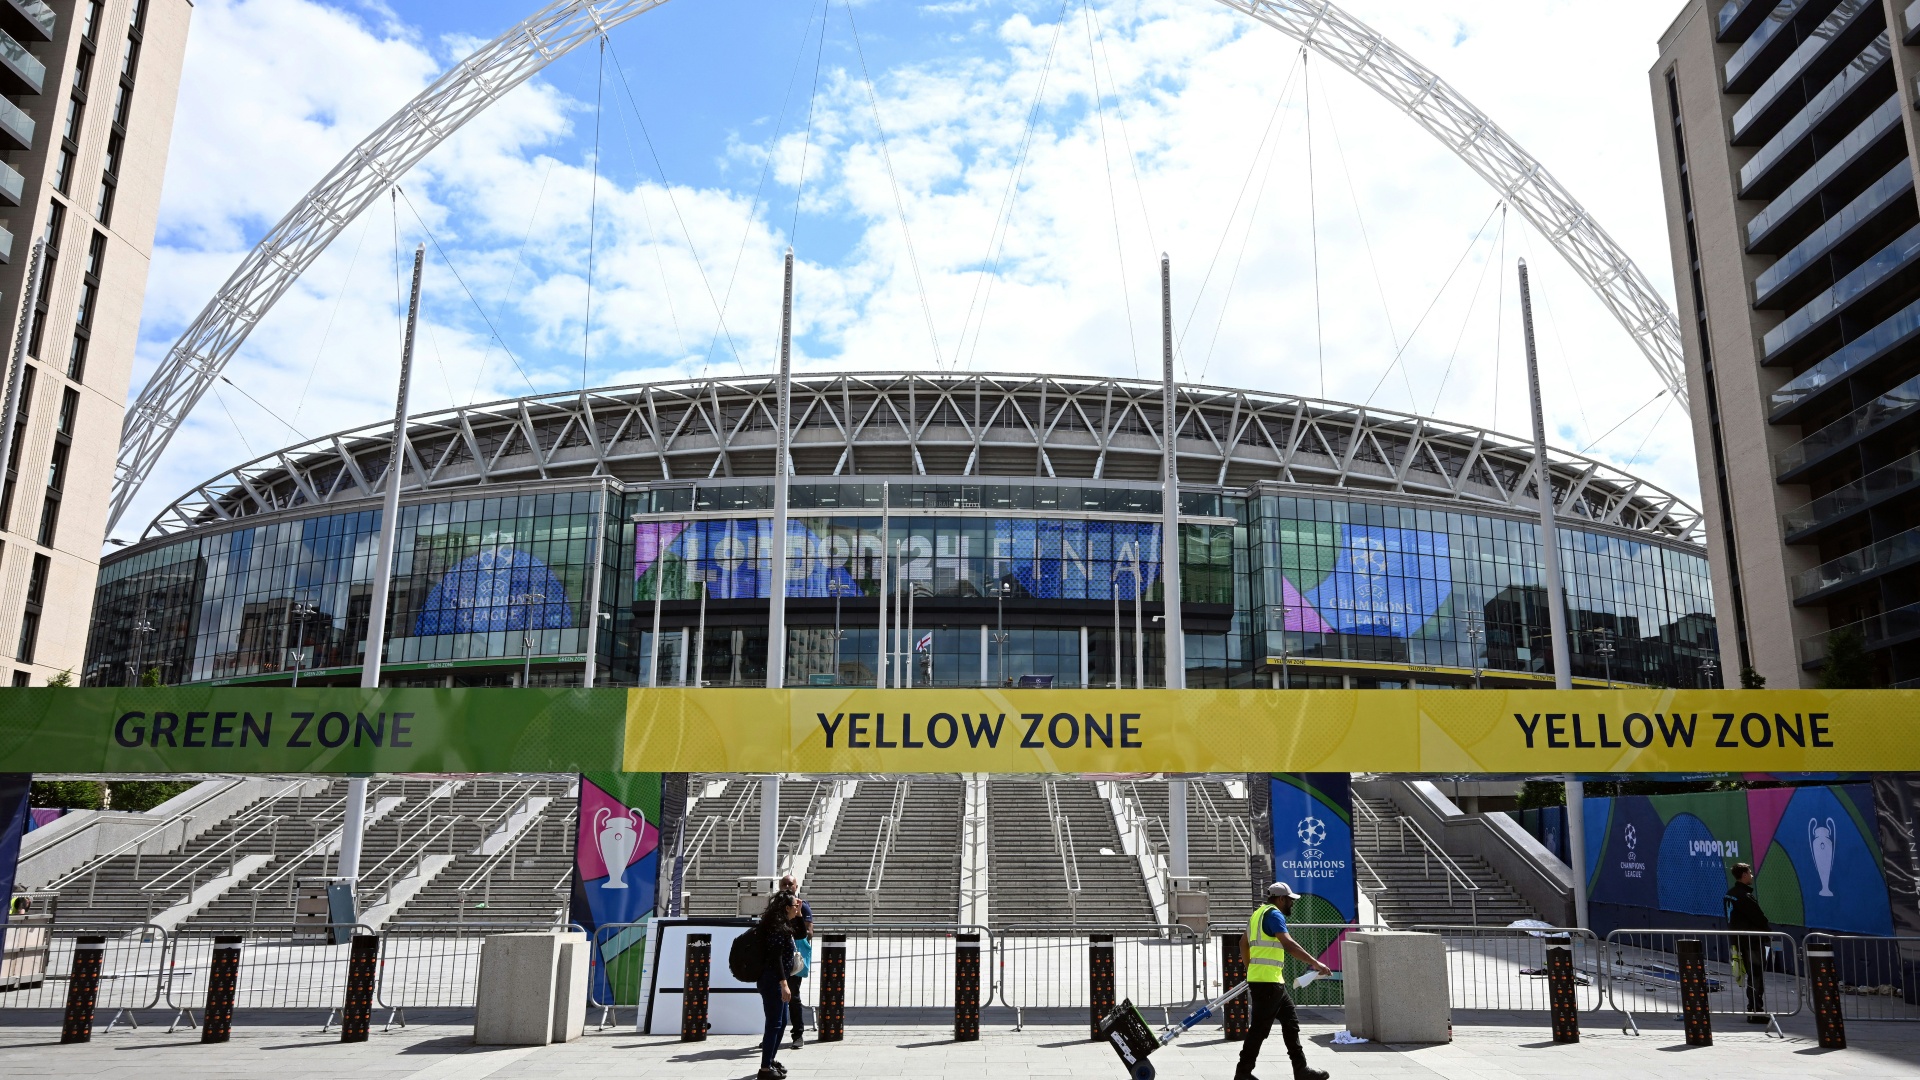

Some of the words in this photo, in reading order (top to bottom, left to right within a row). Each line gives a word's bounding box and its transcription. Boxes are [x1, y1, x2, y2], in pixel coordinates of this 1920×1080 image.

[900, 535, 969, 580] 24
[480, 582, 506, 593] UEFA
[1360, 587, 1385, 598] UEFA
[1329, 598, 1413, 613] CHAMPIONS
[463, 609, 518, 622] LEAGUE
[1346, 613, 1400, 627] LEAGUE
[114, 711, 273, 748] GREEN
[286, 711, 415, 748] ZONE
[816, 712, 1006, 748] YELLOW
[1020, 712, 1143, 748] ZONE
[1513, 712, 1698, 748] YELLOW
[1712, 712, 1834, 748] ZONE
[1725, 841, 1739, 858] 24
[1905, 817, 1920, 871] FINAL
[1303, 851, 1322, 859] UEFA
[1282, 860, 1345, 869] CHAMPIONS
[1620, 861, 1645, 871] CHAMPIONS
[1700, 860, 1728, 869] FINAL
[1294, 870, 1335, 878] LEAGUE
[1625, 870, 1642, 878] LEAGUE
